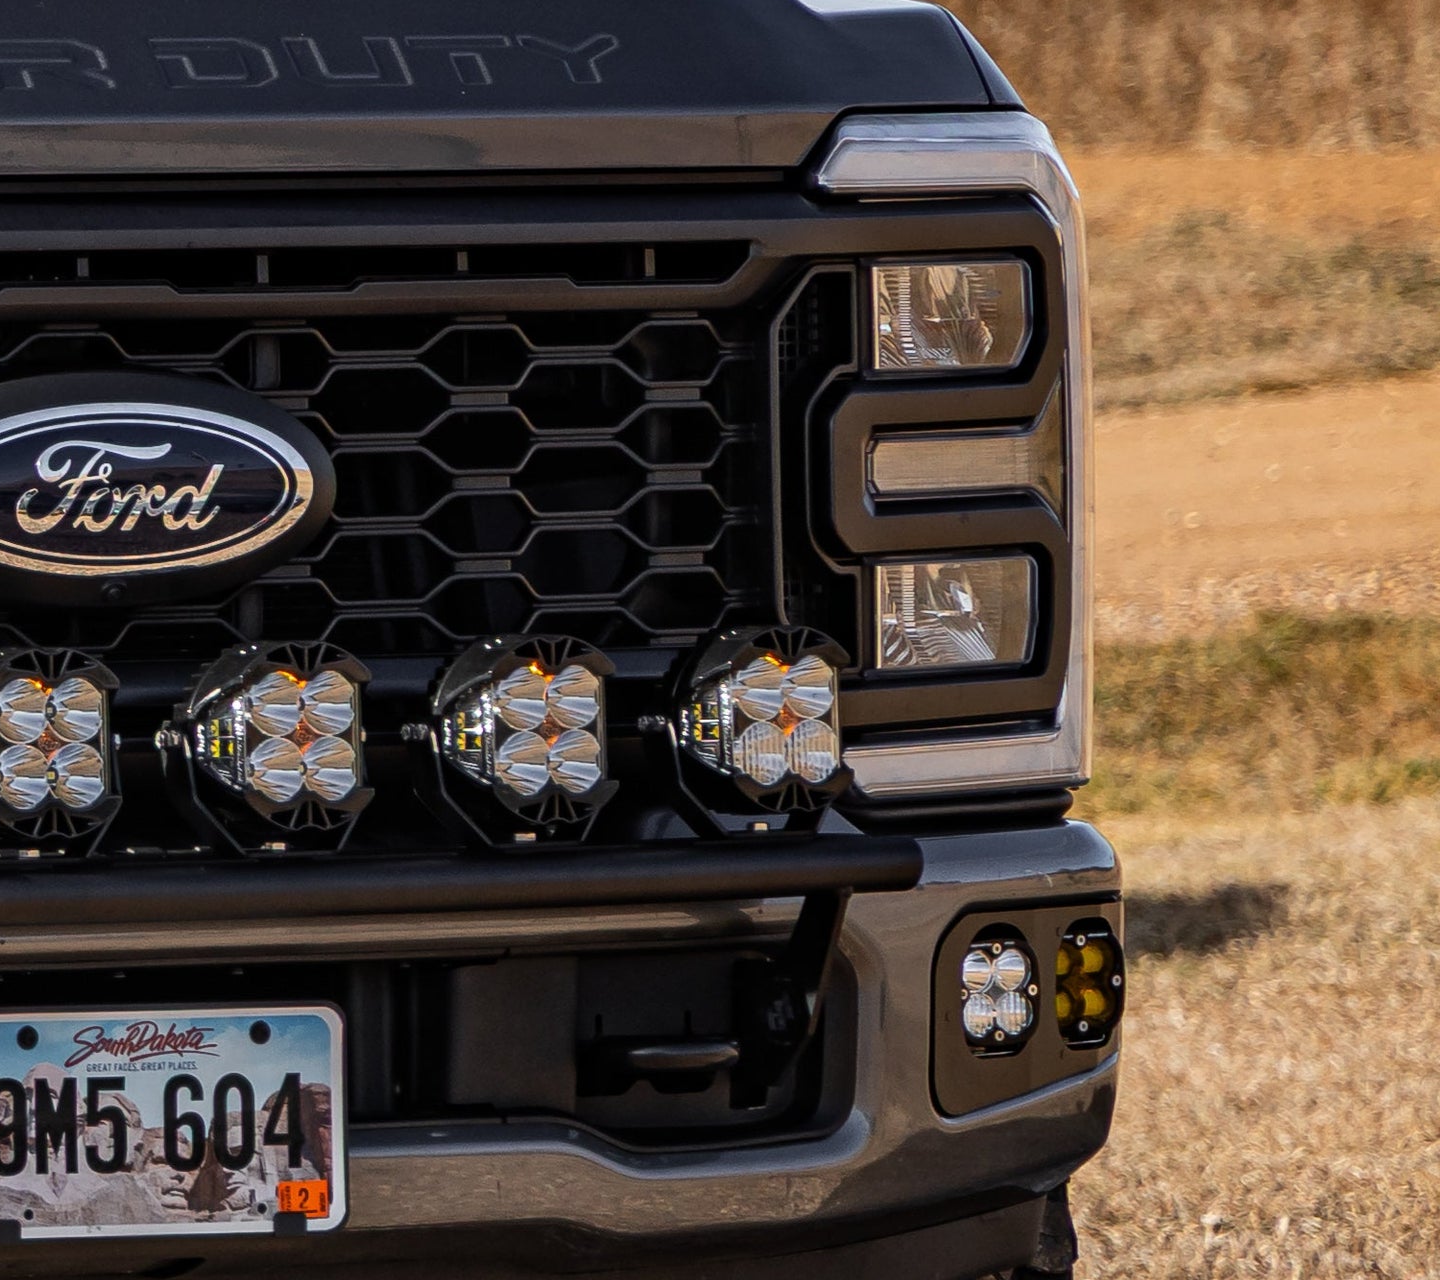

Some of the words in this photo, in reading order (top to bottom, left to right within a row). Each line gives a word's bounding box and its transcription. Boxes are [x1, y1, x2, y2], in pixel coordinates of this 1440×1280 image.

[149, 35, 618, 87] DUTY
[16, 440, 225, 534] Ford
[64, 1025, 140, 1068] South
[126, 1020, 219, 1058] Dakota
[85, 1063, 112, 1073] GREAT
[141, 1061, 166, 1071] GREAT
[163, 1073, 303, 1173] 604
[298, 1187, 309, 1209] 2
